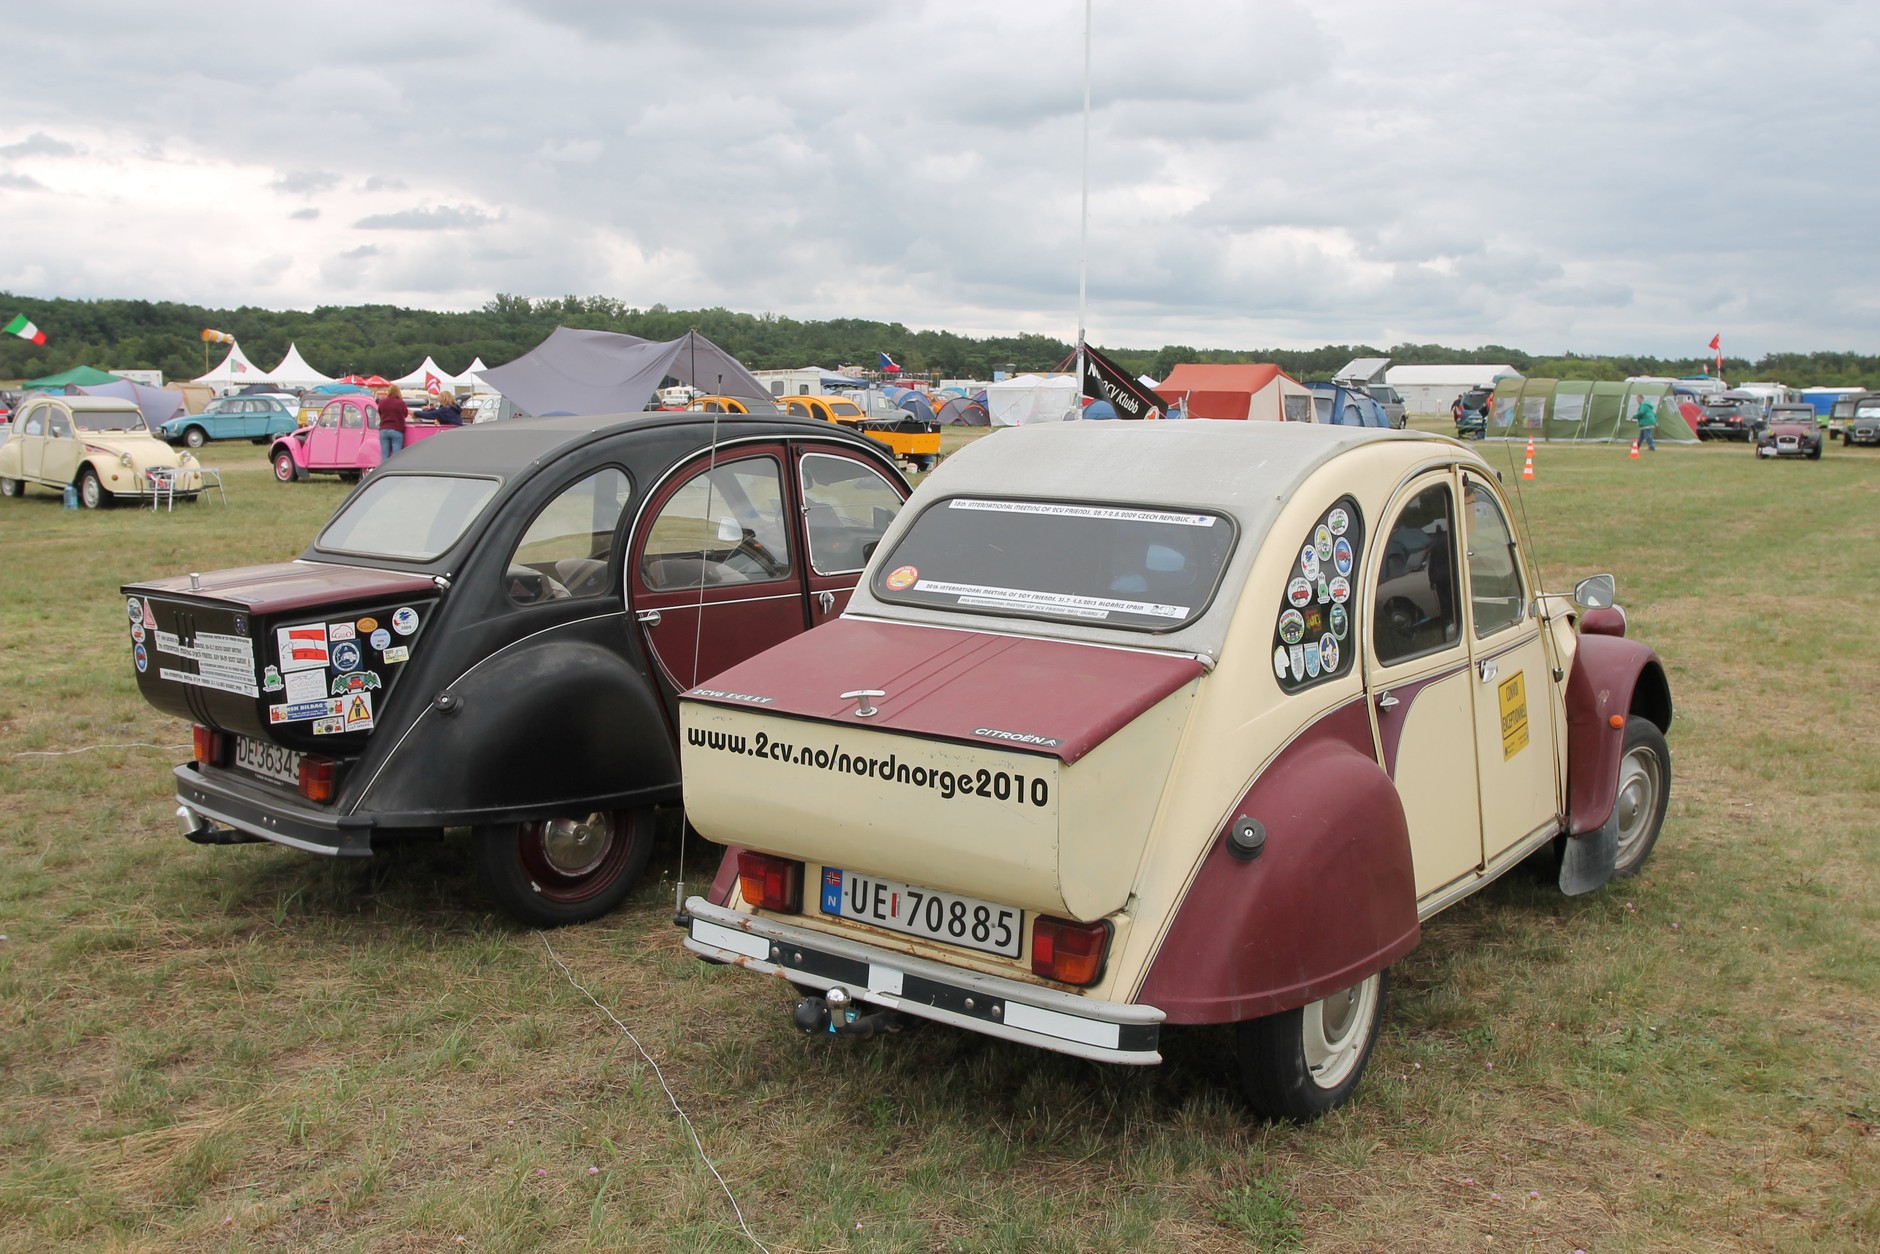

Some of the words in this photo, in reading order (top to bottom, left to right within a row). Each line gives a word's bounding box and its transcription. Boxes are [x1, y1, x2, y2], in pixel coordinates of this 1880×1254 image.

[1116, 391, 1139, 414] Klubb
[968, 502, 1013, 510] INTERNATIONAL
[1013, 504, 1041, 512] MEETING
[1137, 512, 1158, 520] CZECH
[1159, 514, 1191, 522] REPUBLIC
[939, 585, 982, 594] INTERNATIONAL
[983, 588, 1007, 596] MEETING
[975, 728, 1045, 744] CITROËN
[239, 736, 255, 766] DE
[688, 727, 1049, 808] www.2cv.no/nordnorge2010
[828, 895, 837, 907] N
[851, 878, 887, 920] UE
[907, 891, 1013, 947] 70885
